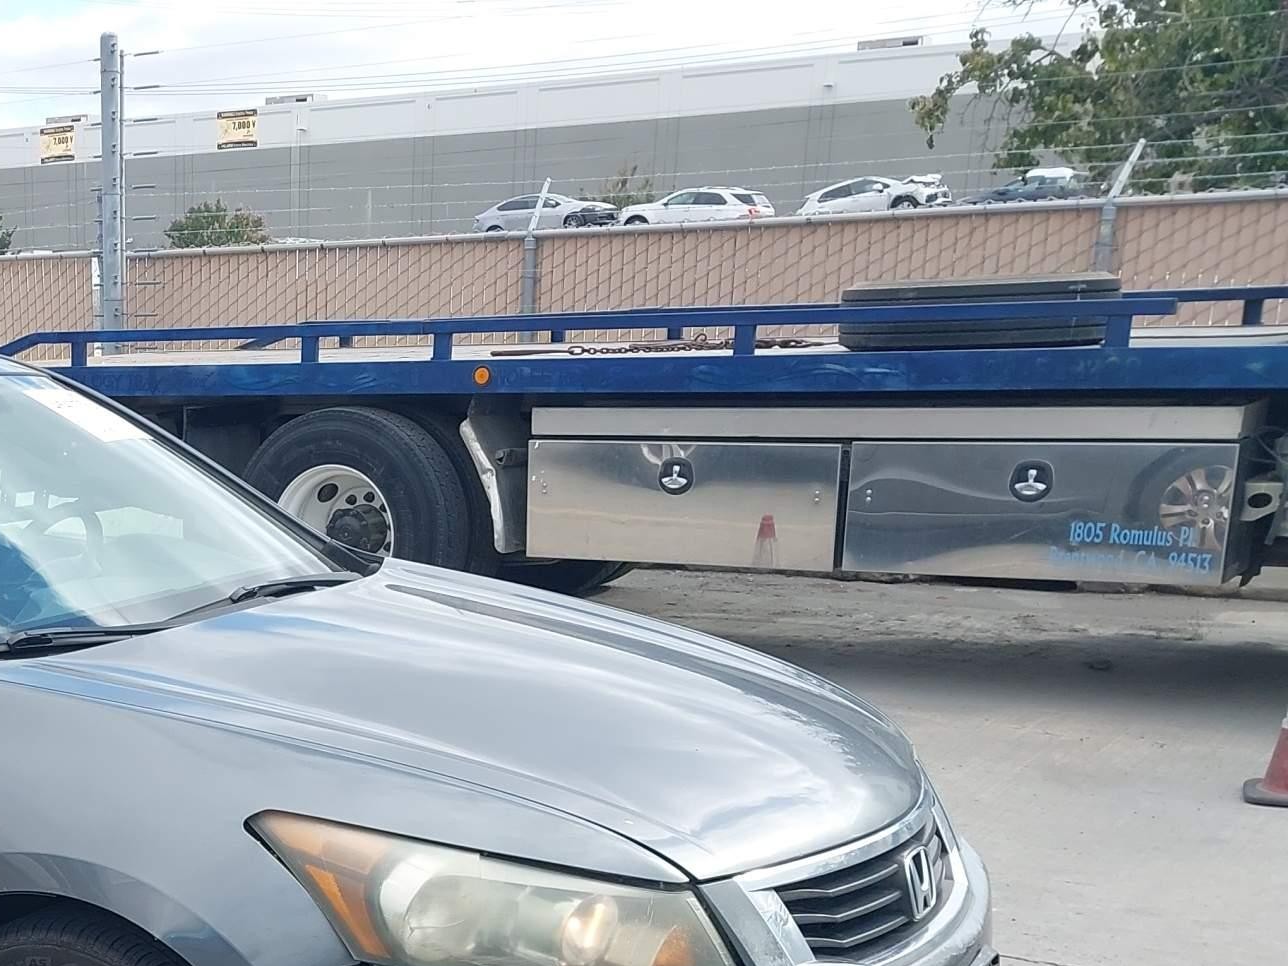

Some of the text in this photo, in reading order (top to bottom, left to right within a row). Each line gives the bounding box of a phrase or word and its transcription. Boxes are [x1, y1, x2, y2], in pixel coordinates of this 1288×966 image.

[232, 120, 251, 131] 7,000
[53, 136, 69, 145] 7,000
[1069, 521, 1106, 544] 1805
[1110, 523, 1173, 547] Romulus
[1169, 551, 1213, 573] 94513
